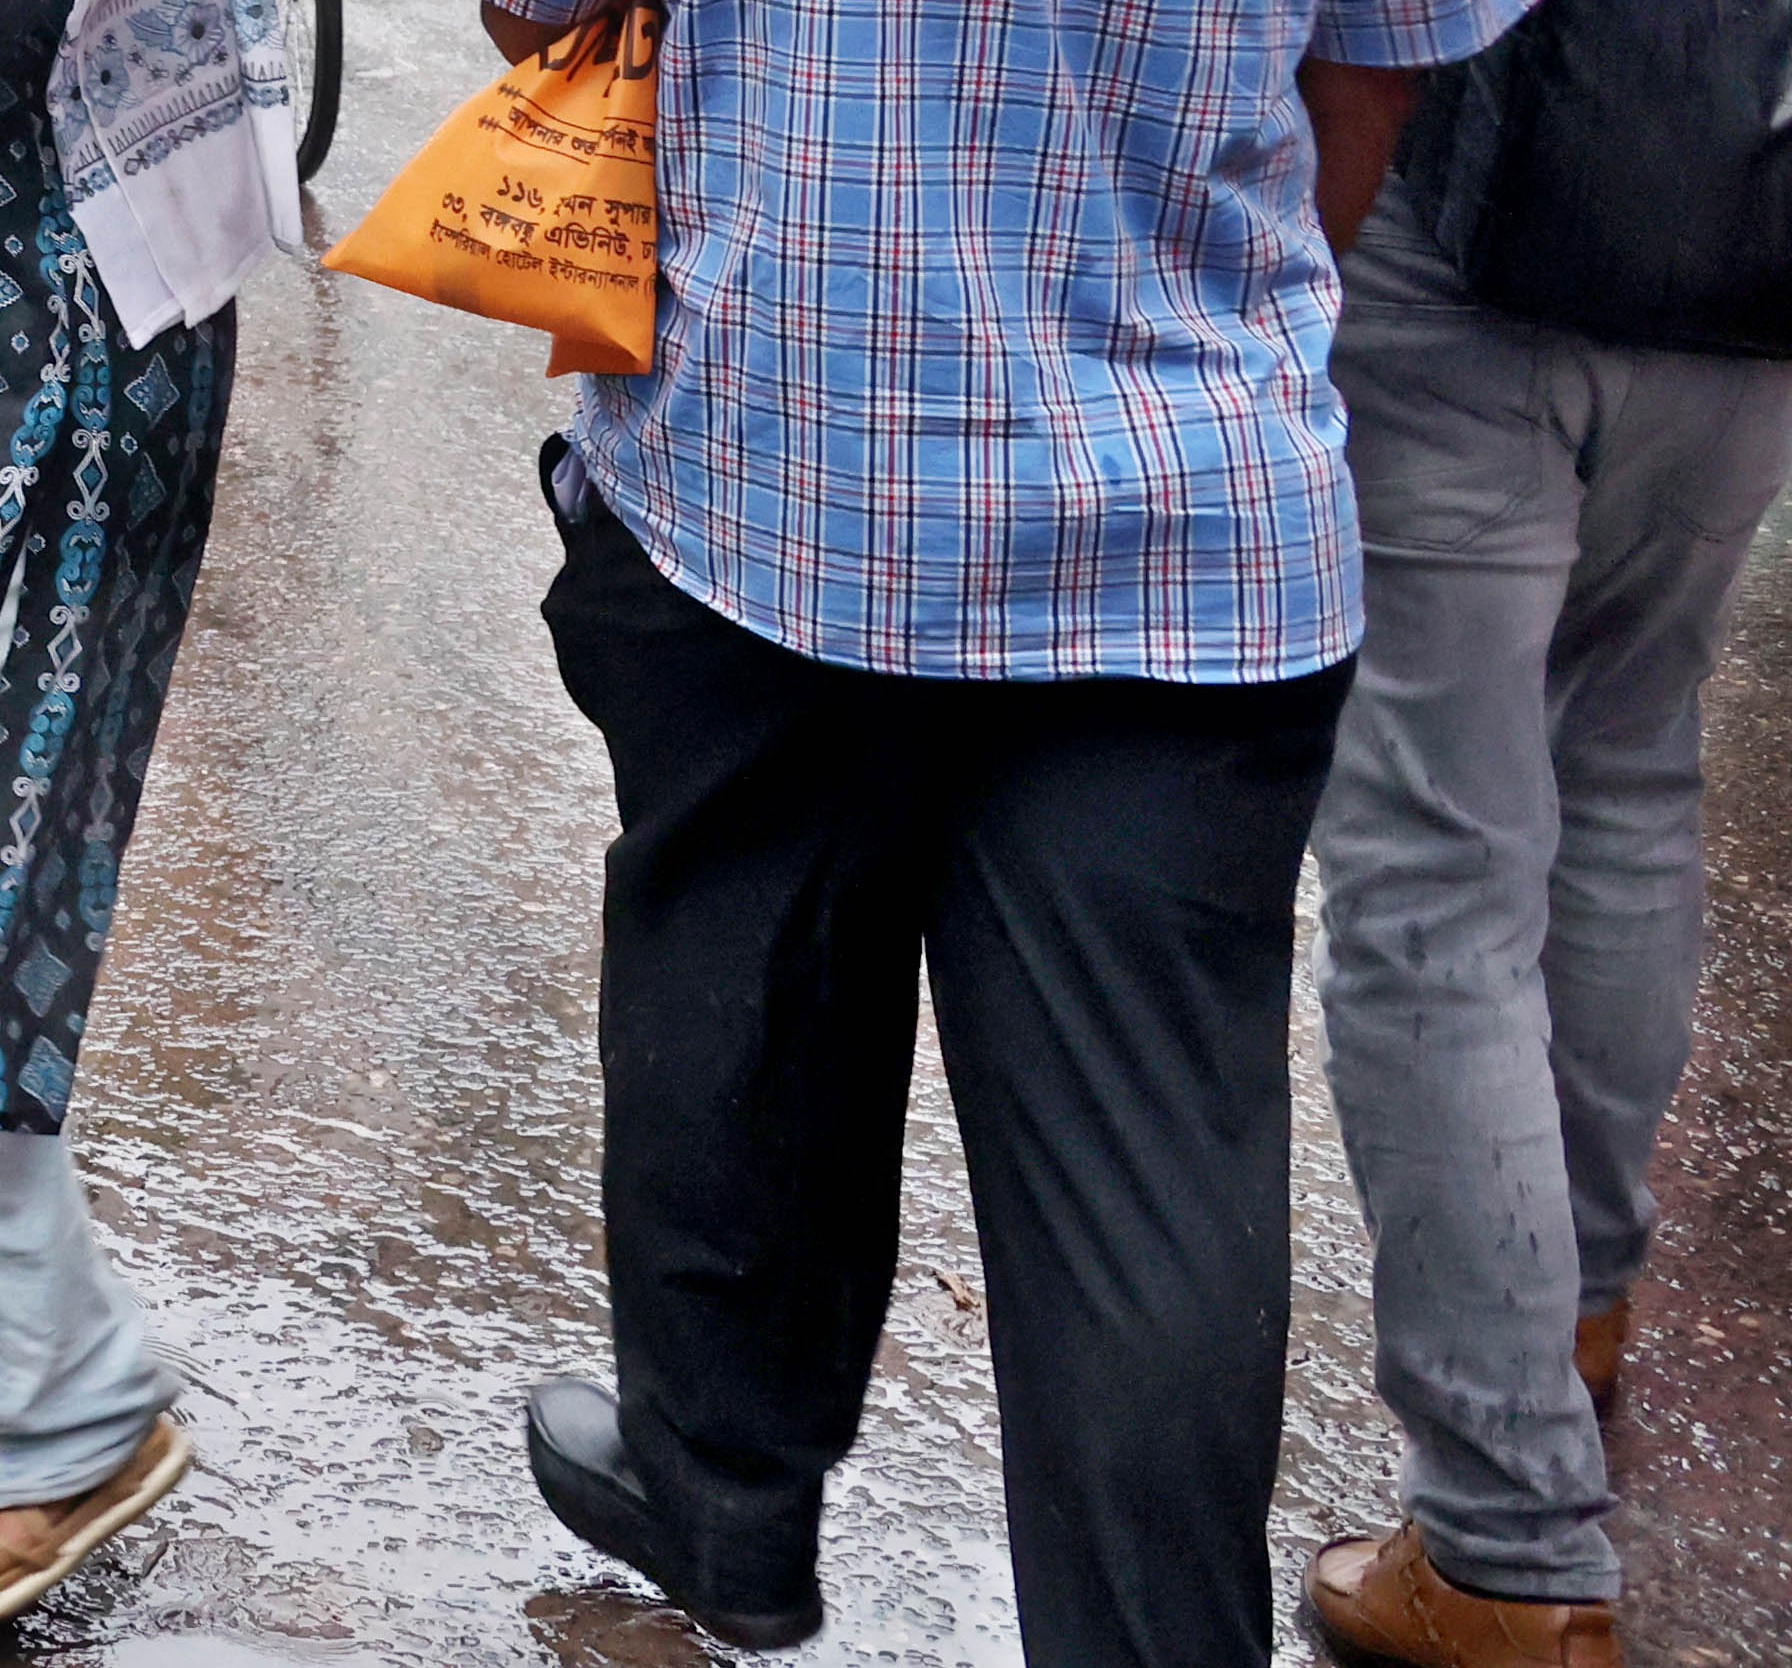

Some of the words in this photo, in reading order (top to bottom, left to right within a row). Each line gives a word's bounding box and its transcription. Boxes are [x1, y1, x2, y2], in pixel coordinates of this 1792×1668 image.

[507, 106, 568, 146] আপনার
[497, 175, 546, 216] ১১৬,
[603, 198, 654, 227] সুপার
[480, 203, 539, 247] বঙ্গবন্ধু
[544, 222, 632, 263] এভিনিউ,
[496, 249, 544, 272] হোটেল
